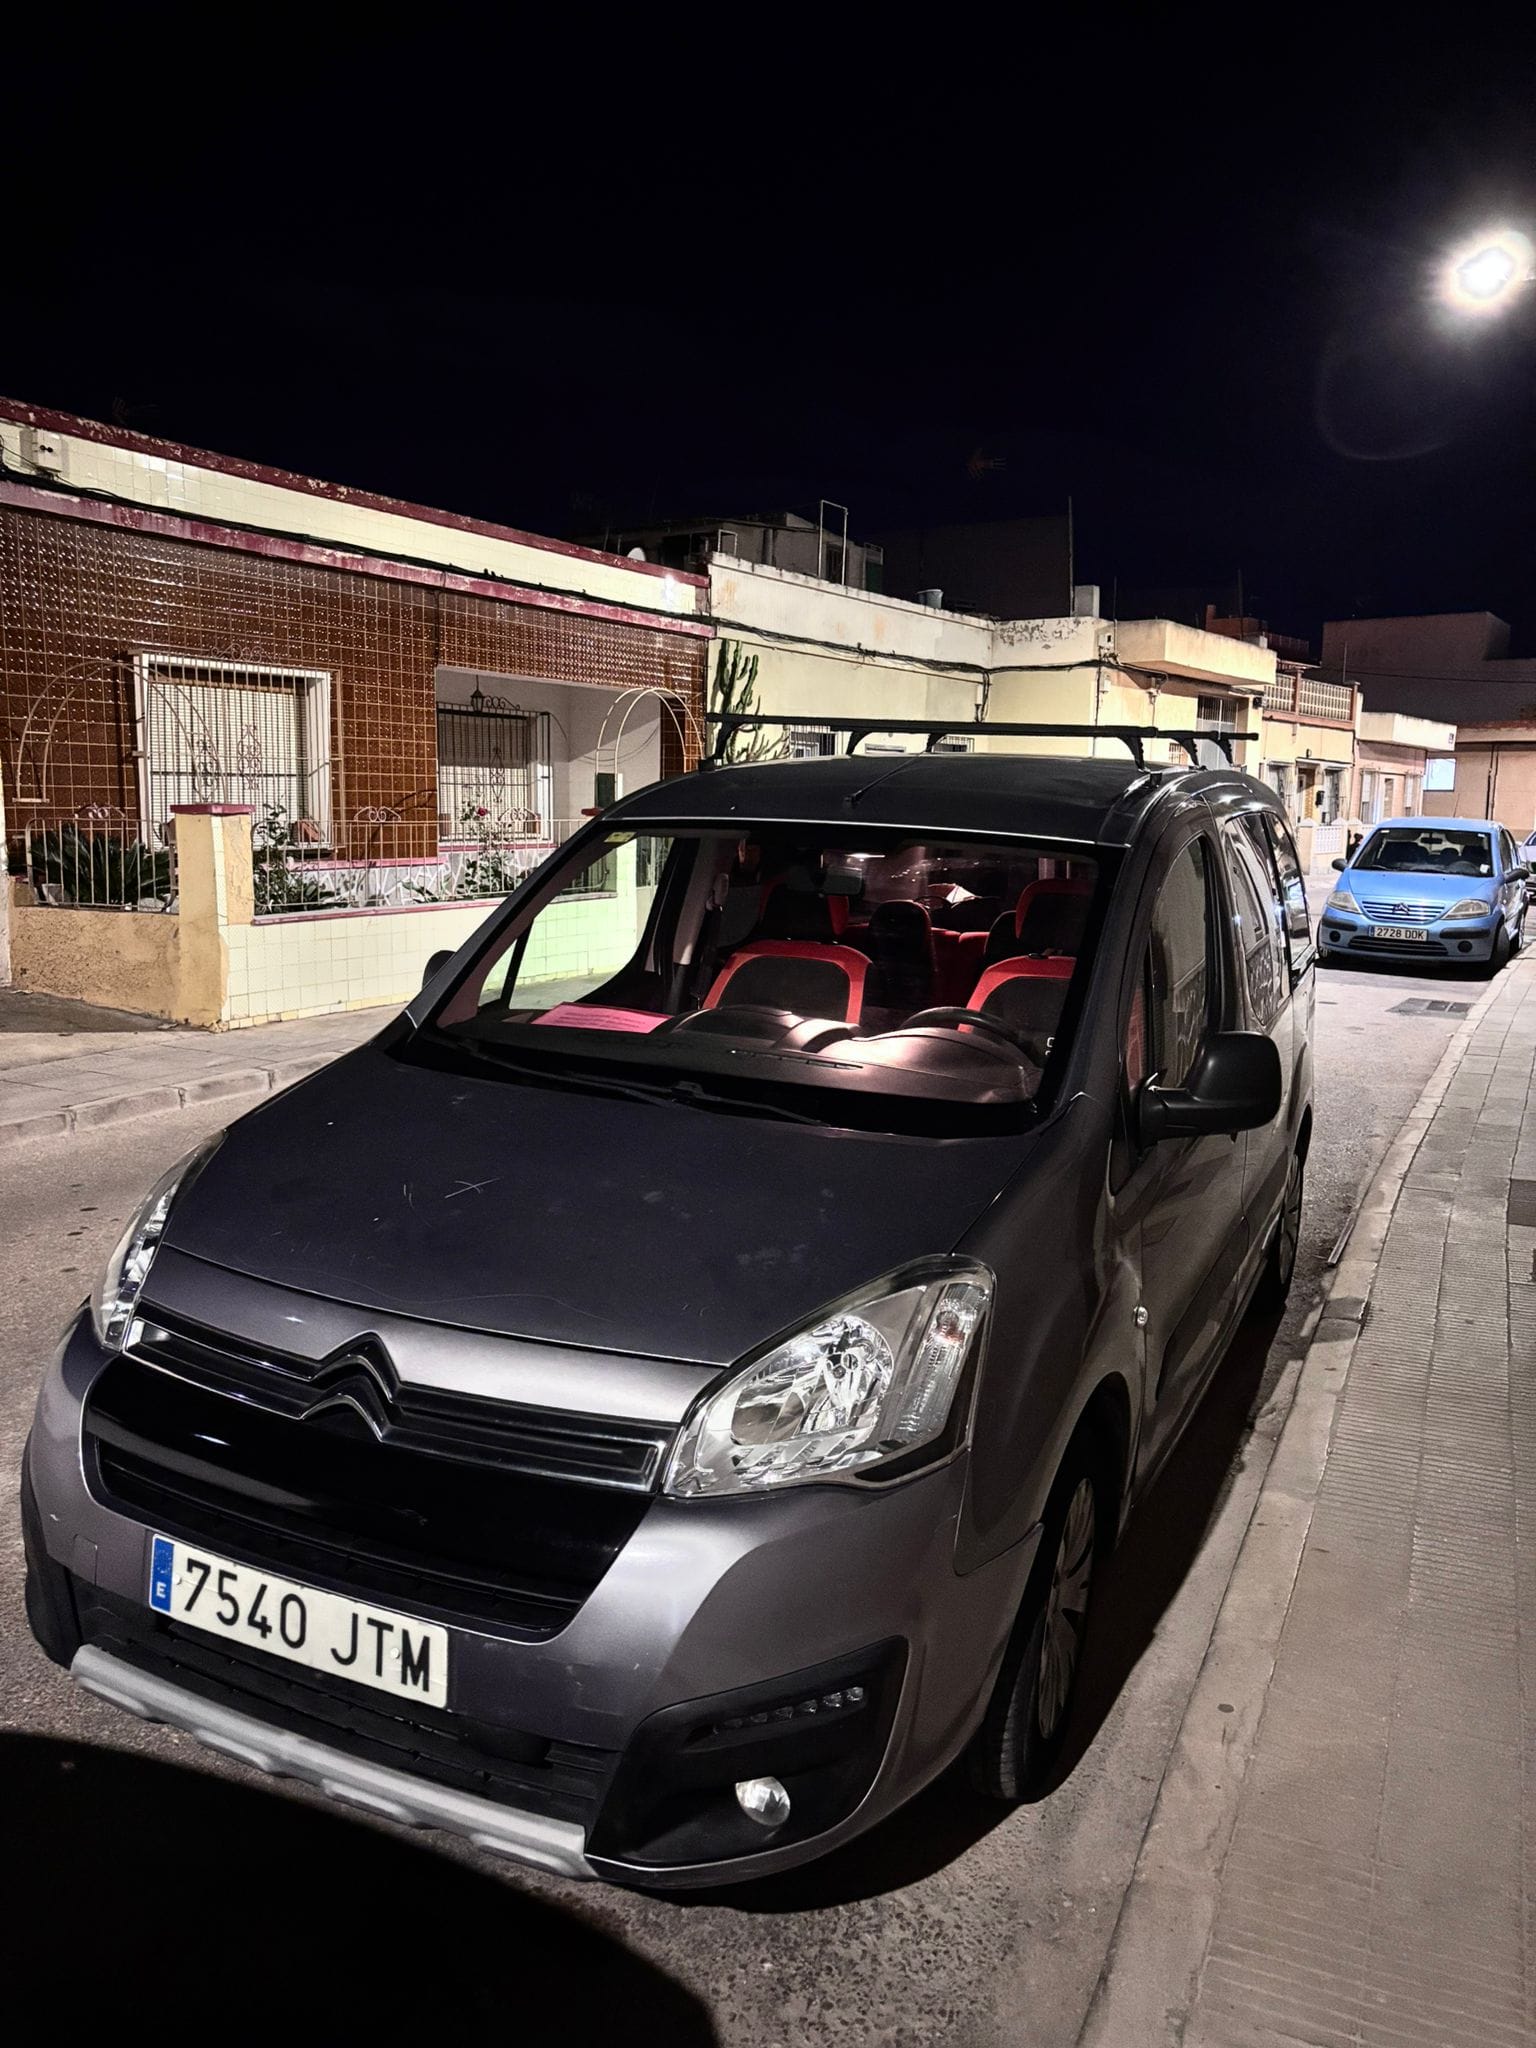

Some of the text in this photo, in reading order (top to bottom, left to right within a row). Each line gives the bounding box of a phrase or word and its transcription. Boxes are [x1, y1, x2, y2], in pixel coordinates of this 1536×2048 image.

[1376, 927, 1425, 940] 2728 DDK
[155, 1581, 167, 1599] E
[183, 1557, 431, 1692] 7540 JTM
